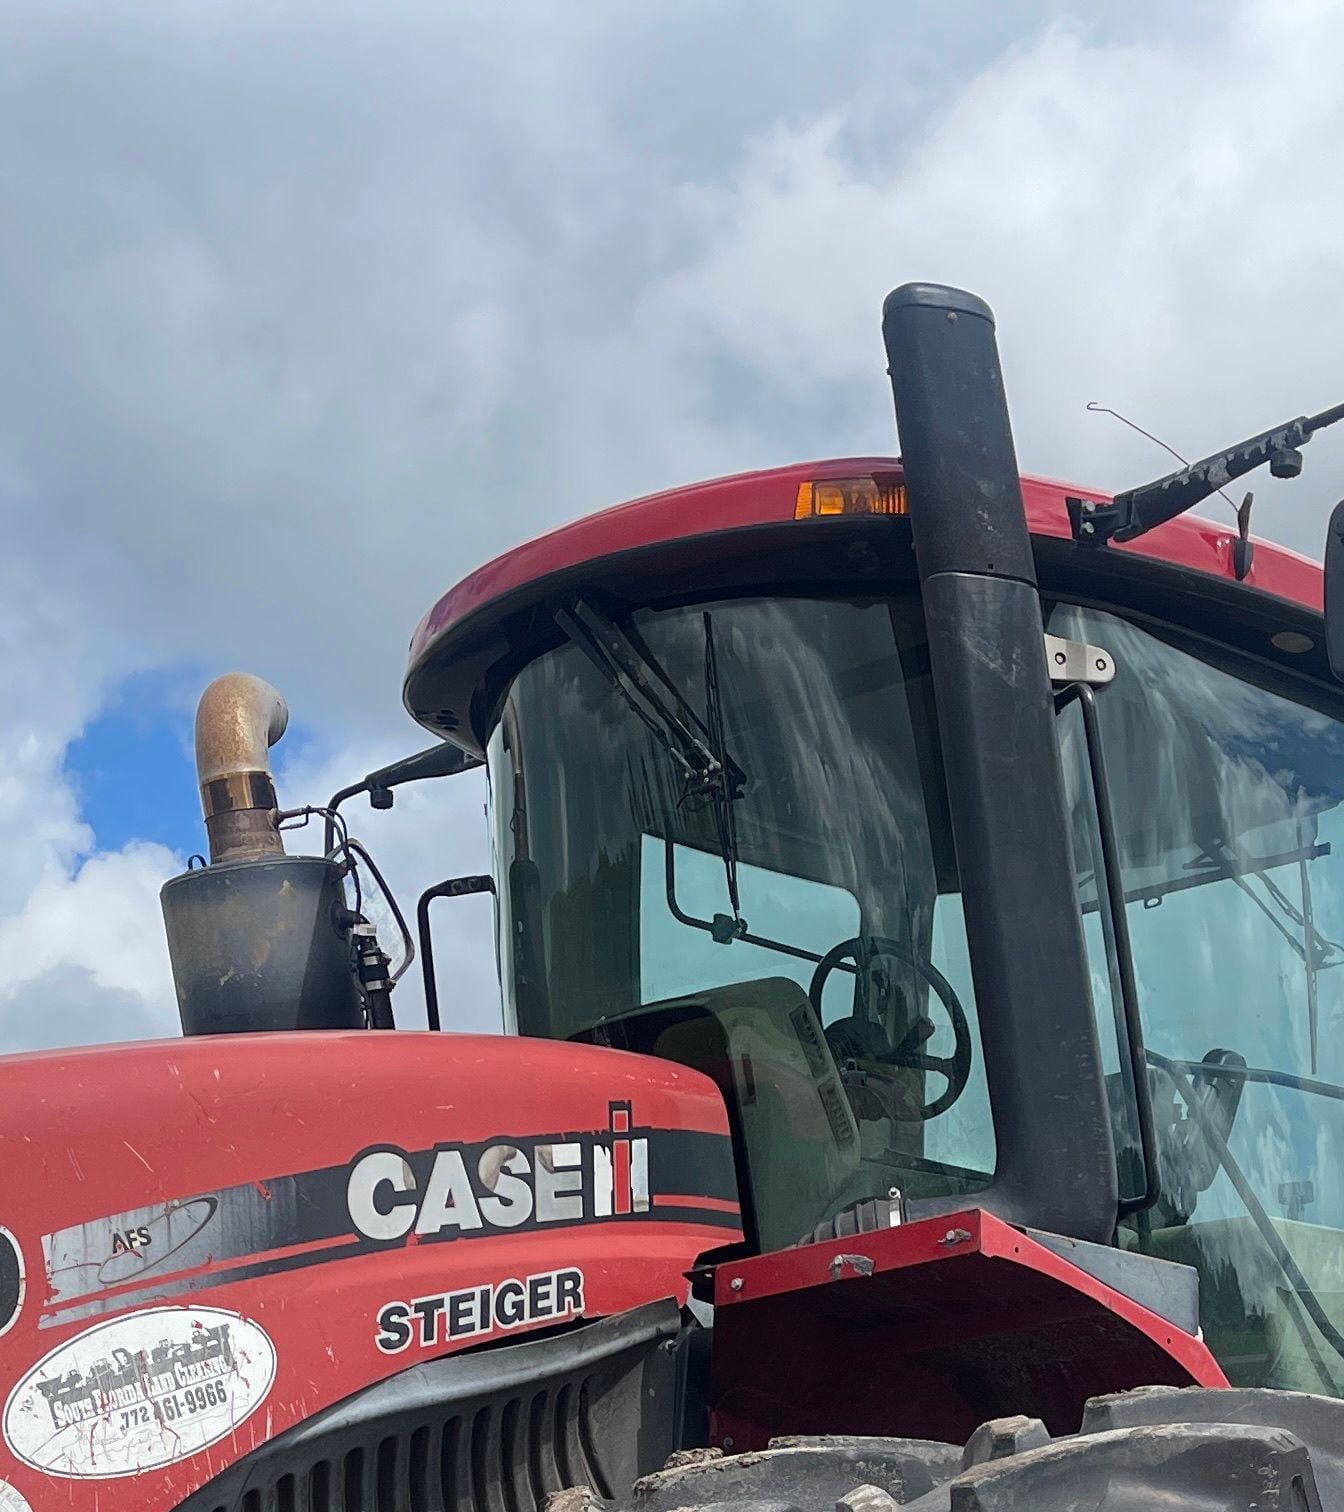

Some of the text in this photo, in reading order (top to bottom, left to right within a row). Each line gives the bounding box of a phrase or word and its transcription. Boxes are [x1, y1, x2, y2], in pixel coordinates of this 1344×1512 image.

[347, 1142, 585, 1241] CASE
[112, 1226, 152, 1255] AFS
[375, 1267, 585, 1355] STEIGER
[154, 1380, 227, 1421] 61-9966
